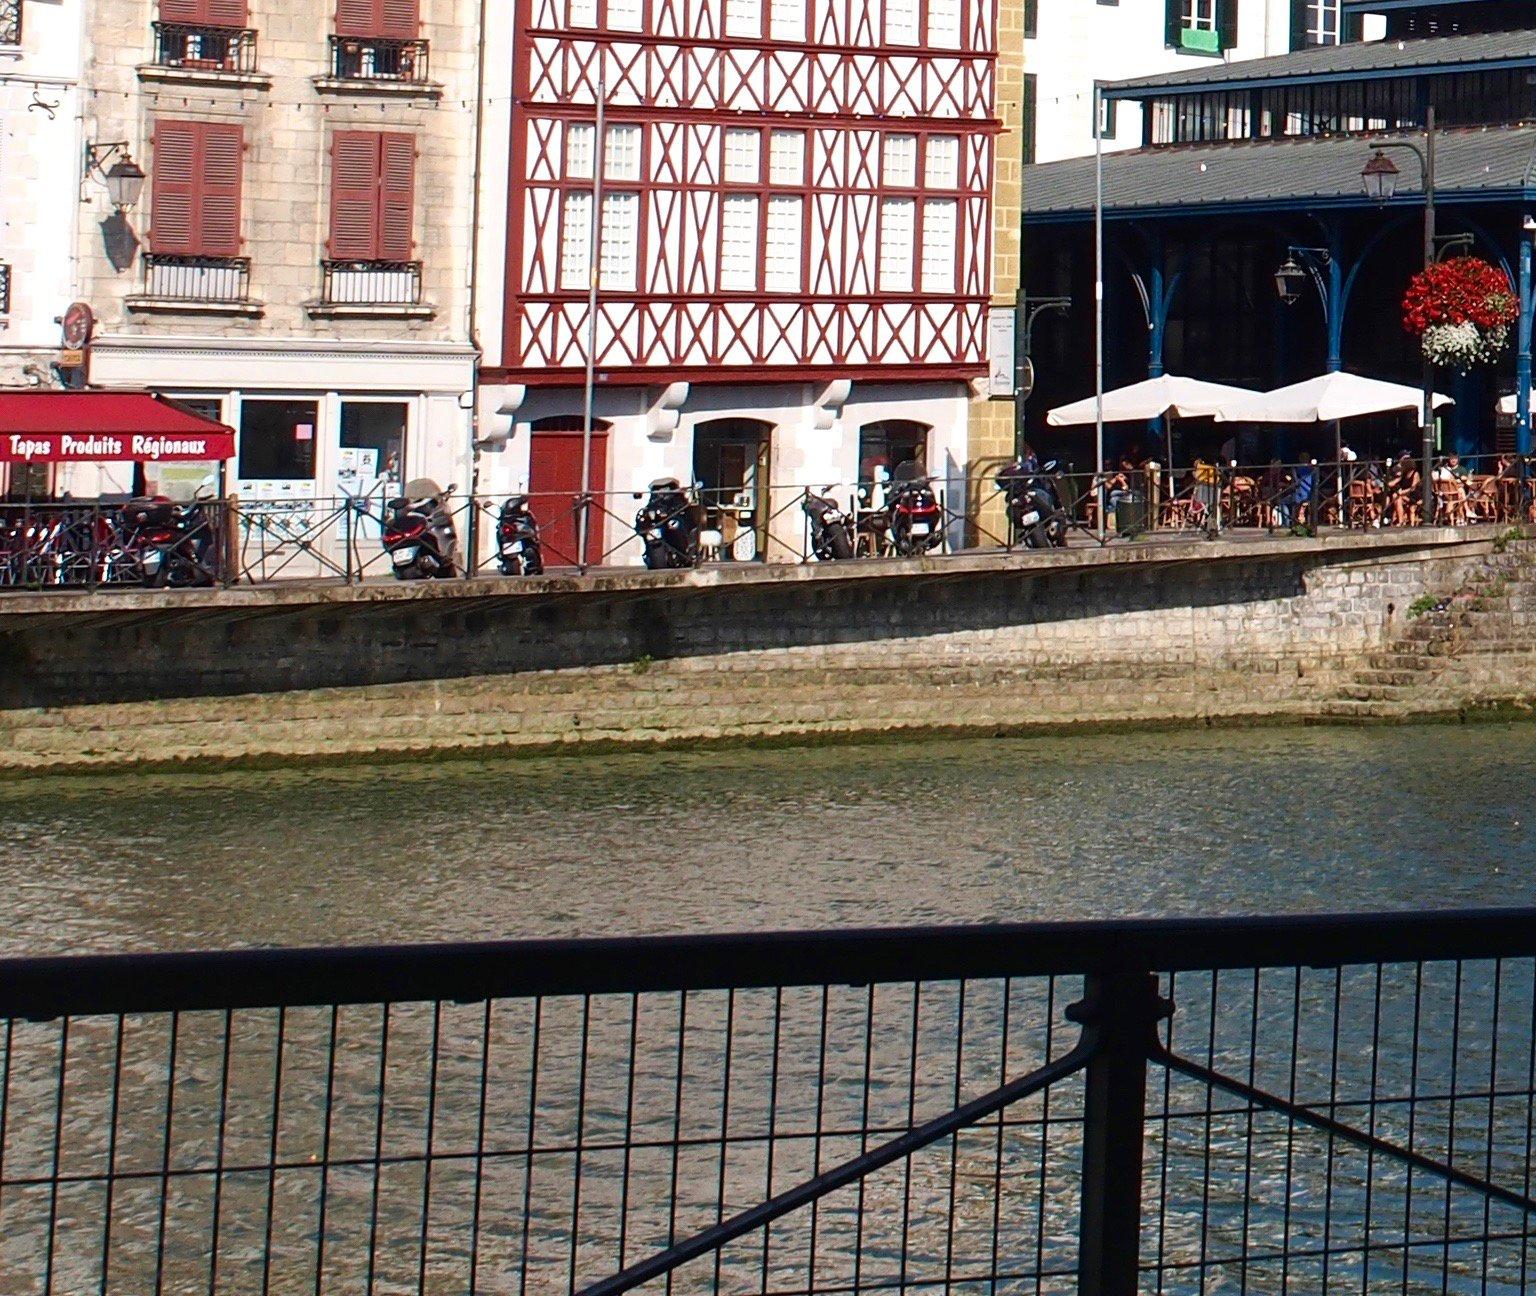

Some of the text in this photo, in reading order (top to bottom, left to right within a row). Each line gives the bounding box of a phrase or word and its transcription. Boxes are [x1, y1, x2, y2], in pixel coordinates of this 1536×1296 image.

[10, 435, 206, 459] Tapas Produits Régionaux
